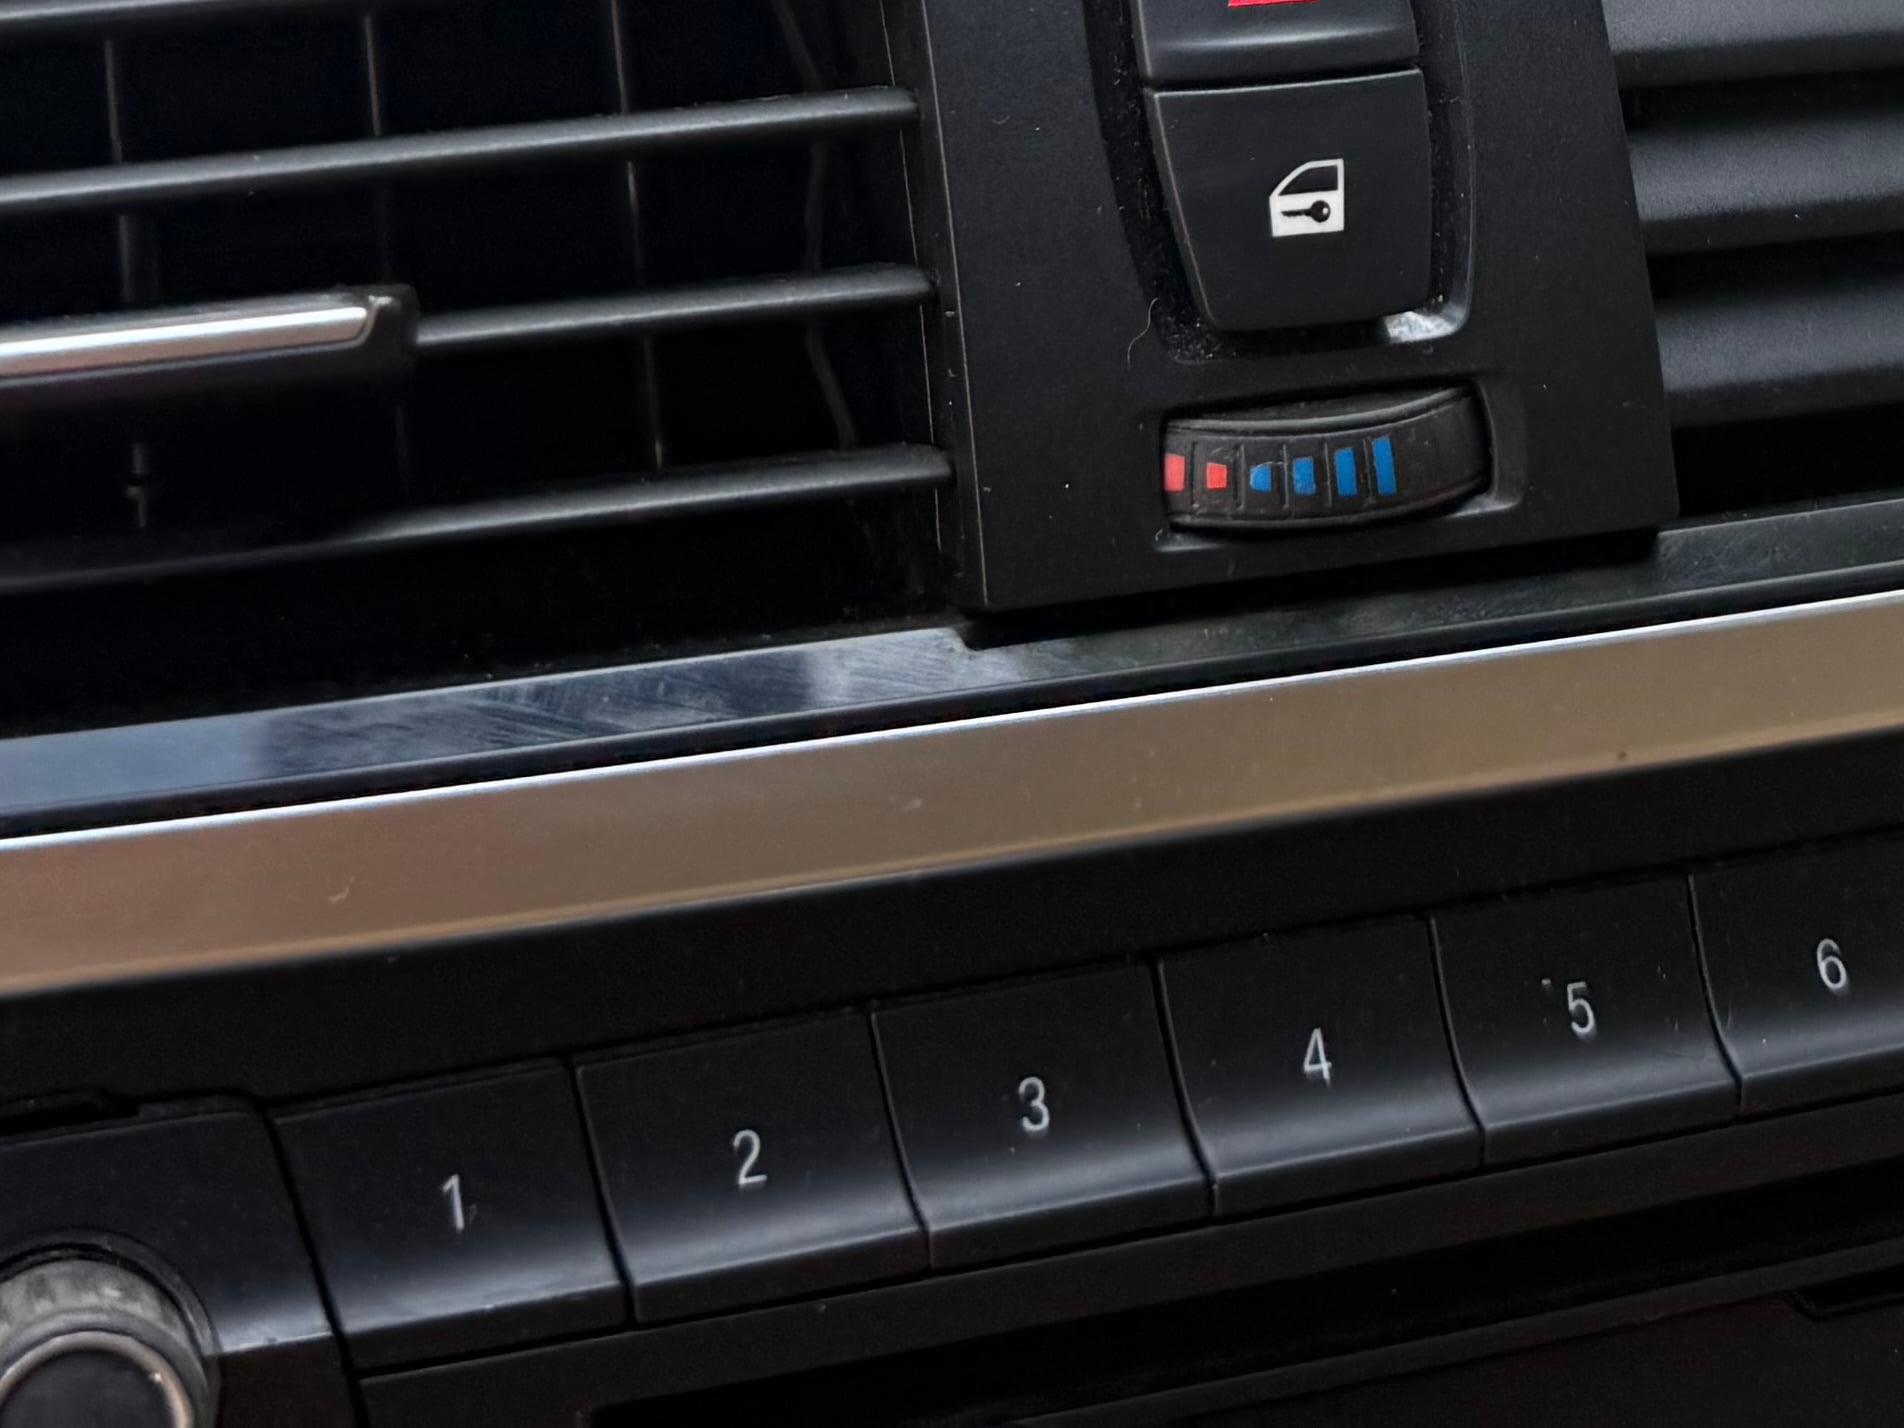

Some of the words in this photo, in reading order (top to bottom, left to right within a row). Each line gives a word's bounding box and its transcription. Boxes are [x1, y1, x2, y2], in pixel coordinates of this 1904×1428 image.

[1818, 939, 1848, 992] 6
[1566, 981, 1597, 1037] 5
[1302, 1029, 1333, 1086] 4
[1018, 1077, 1050, 1134] 3
[733, 1130, 767, 1188] 2
[442, 1175, 467, 1233] 1
